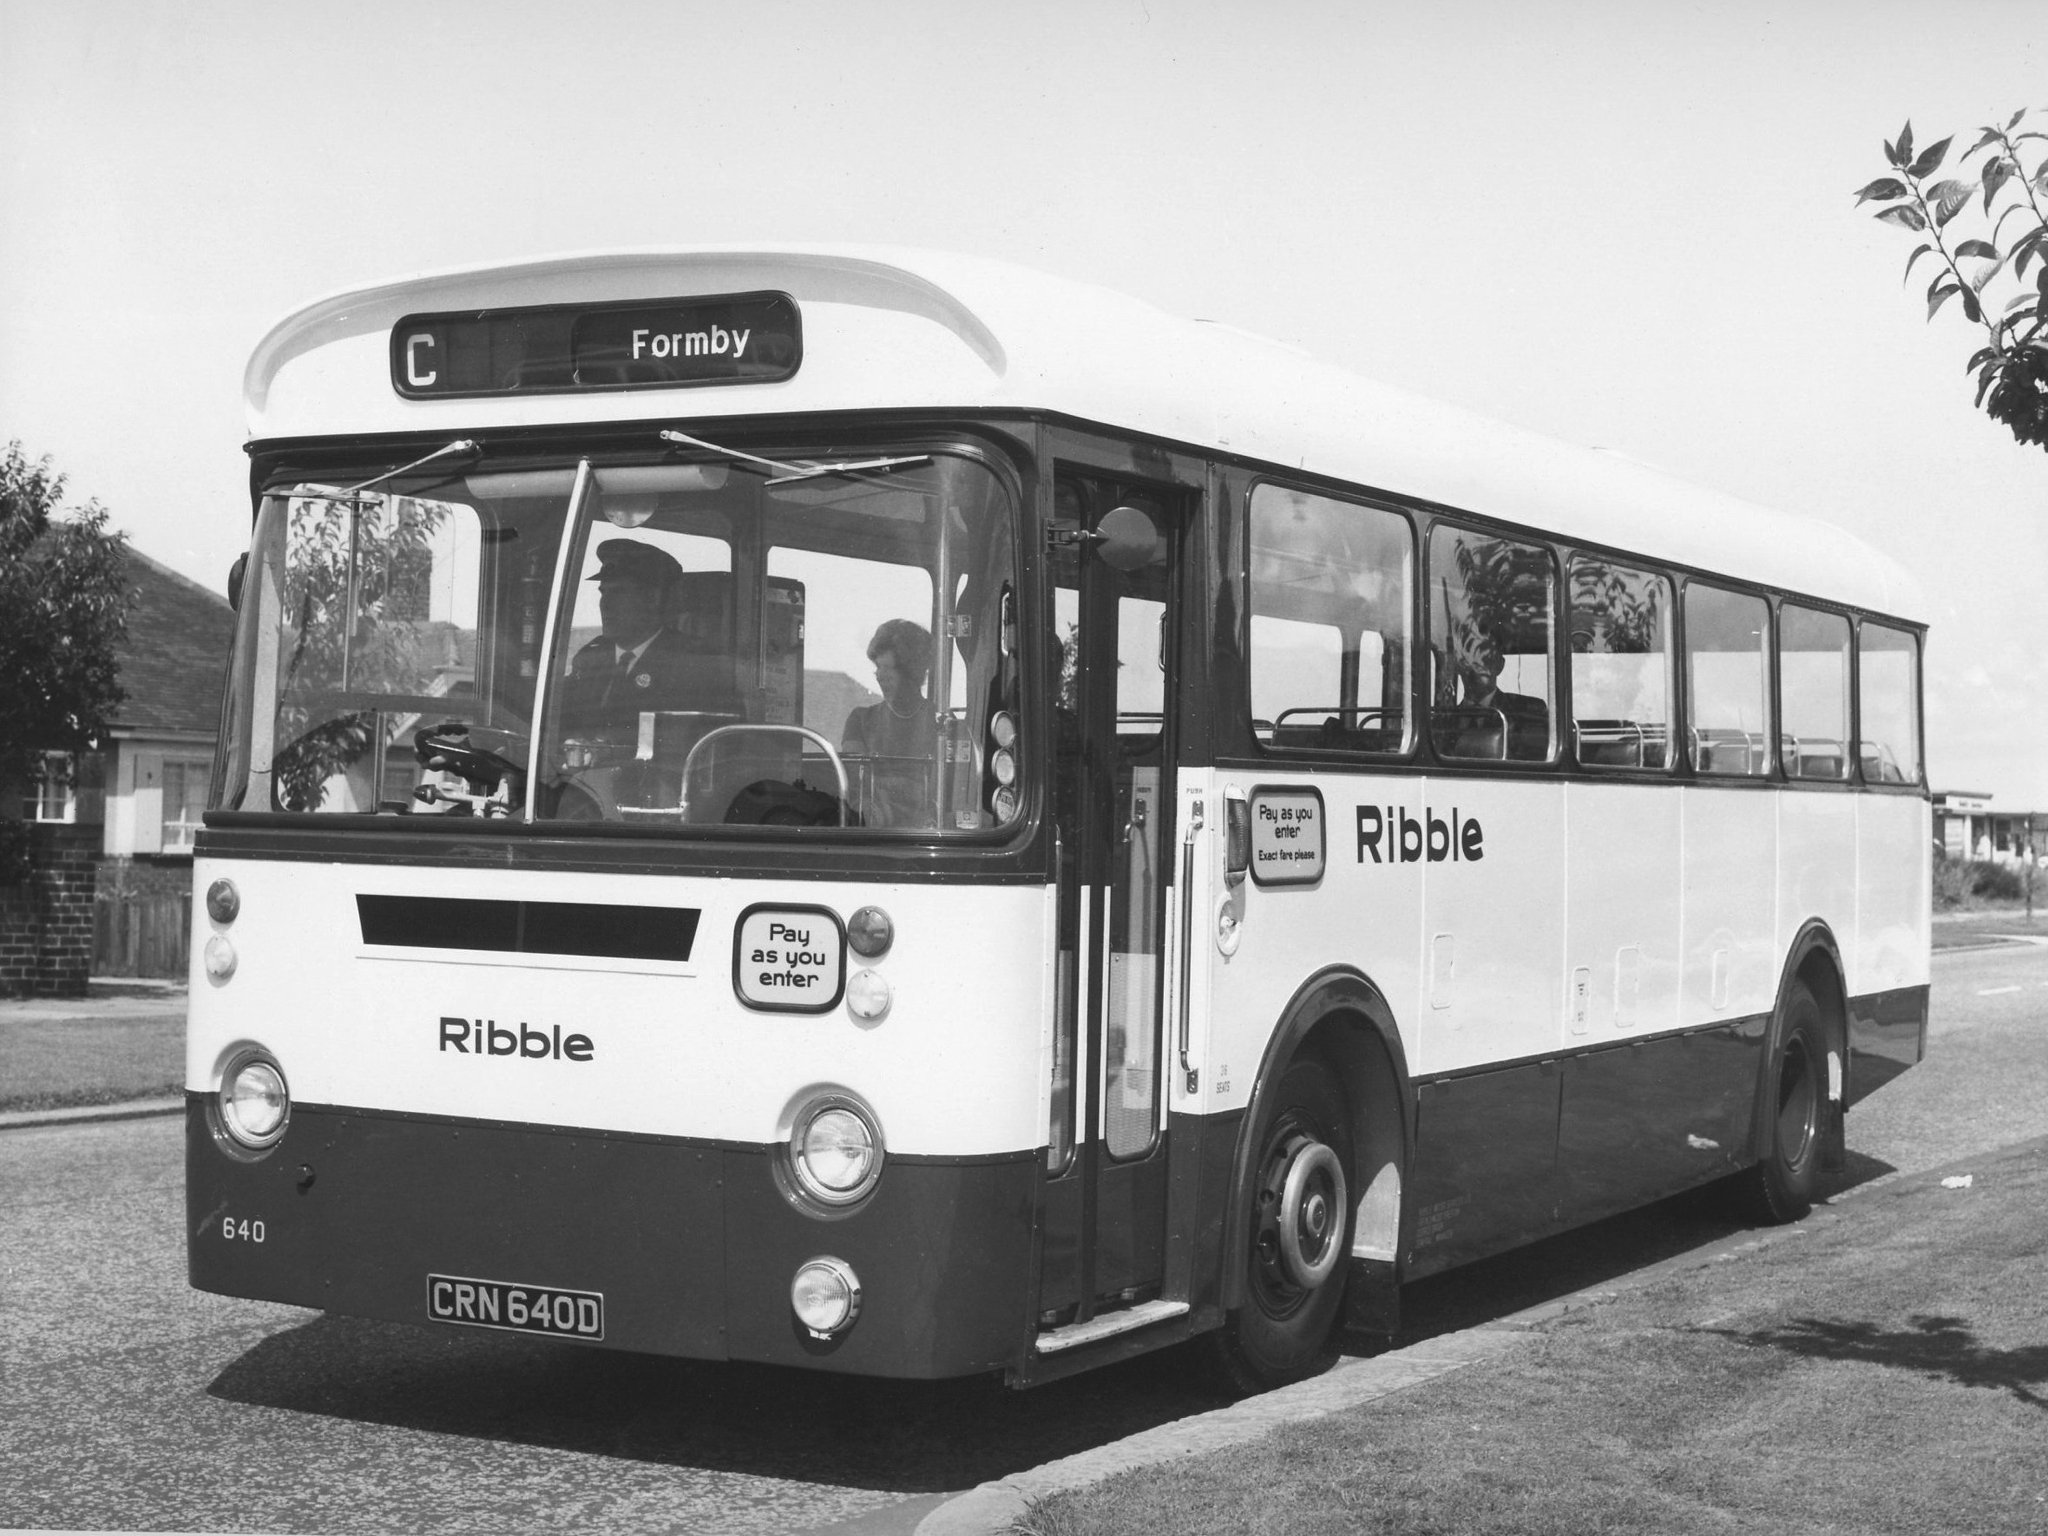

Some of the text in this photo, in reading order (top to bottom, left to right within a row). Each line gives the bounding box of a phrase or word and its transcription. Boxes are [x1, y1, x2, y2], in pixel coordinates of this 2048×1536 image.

[632, 324, 751, 360] Formby
[407, 333, 437, 387] C
[1259, 804, 1313, 825] Pay as you
[1275, 824, 1301, 839] enter
[1355, 804, 1484, 864] Ribble
[1258, 848, 1316, 862] Exact fare please
[769, 922, 810, 948] Pay
[751, 949, 826, 969] as you
[758, 970, 819, 988] enter
[439, 1016, 595, 1062] Ribble
[223, 1216, 265, 1243] 640
[433, 1281, 500, 1322] CRN
